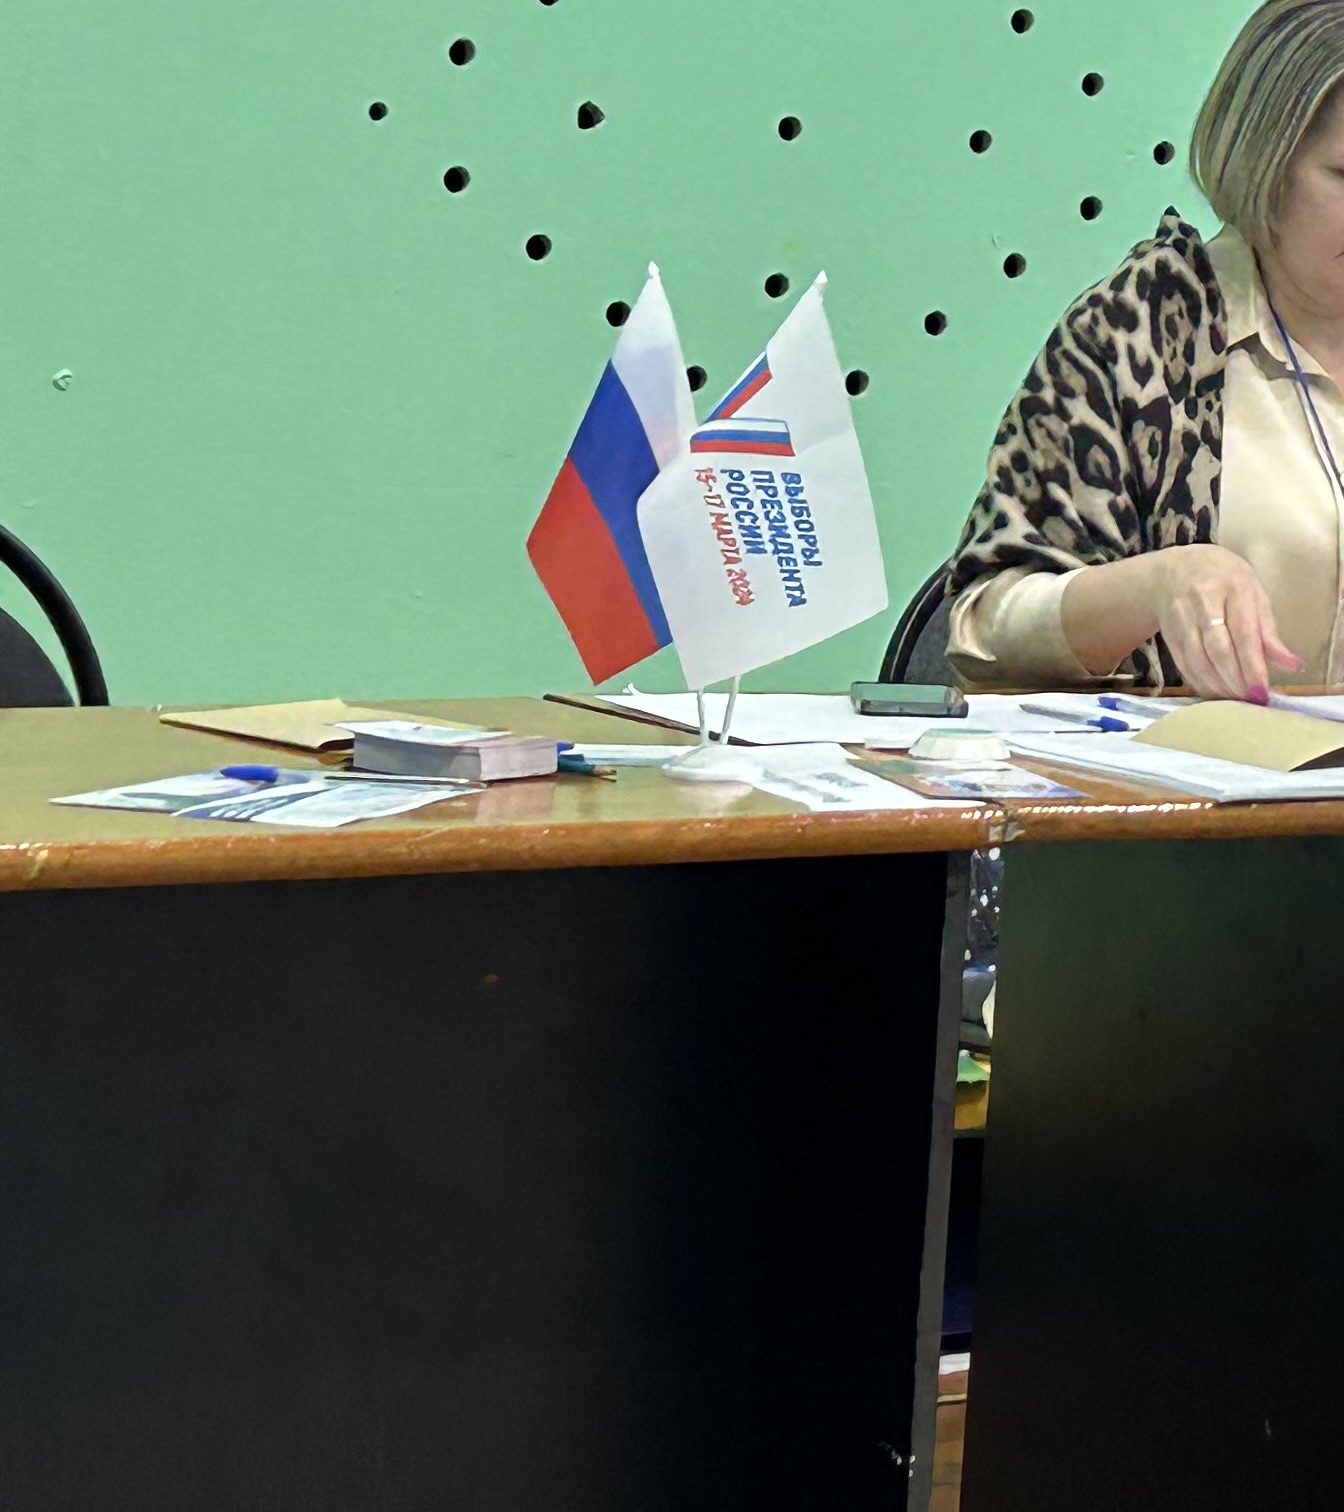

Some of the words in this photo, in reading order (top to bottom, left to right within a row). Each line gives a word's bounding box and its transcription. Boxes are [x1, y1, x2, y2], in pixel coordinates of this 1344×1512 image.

[720, 468, 768, 555] РОССИИ
[749, 470, 808, 608] ПРЕЗИДЕНТА
[780, 471, 823, 567] ВЫБОРЫ
